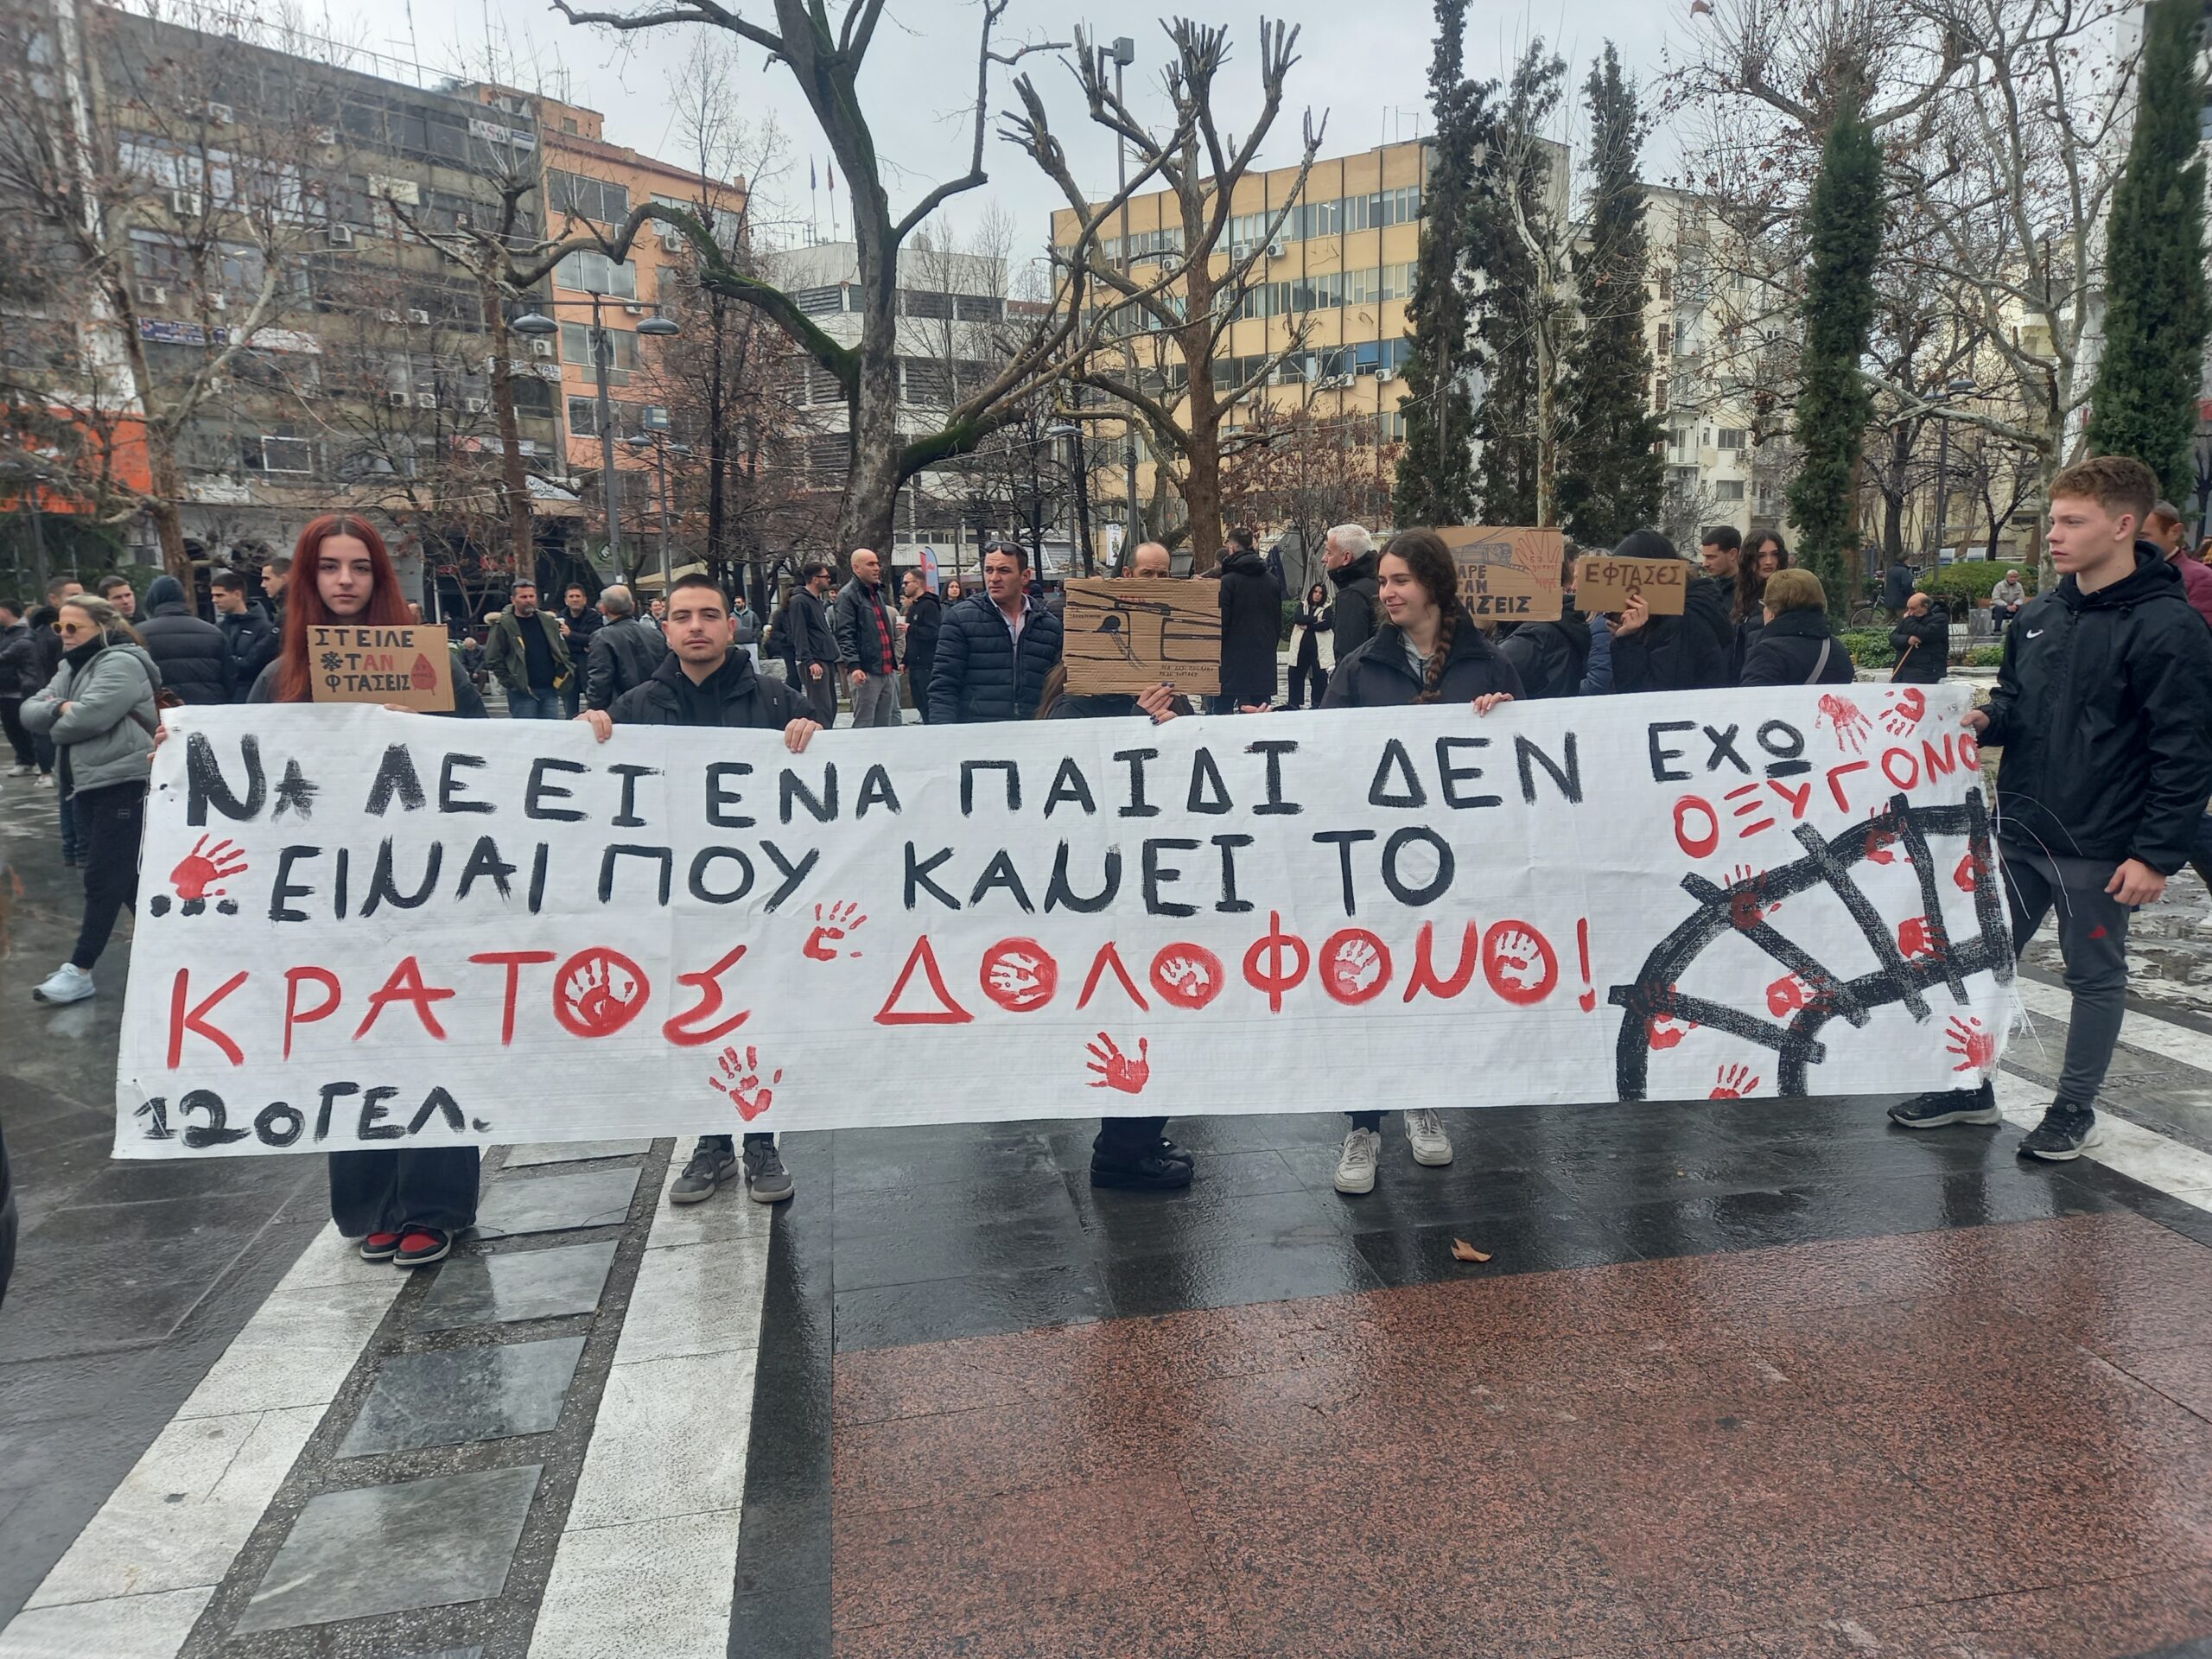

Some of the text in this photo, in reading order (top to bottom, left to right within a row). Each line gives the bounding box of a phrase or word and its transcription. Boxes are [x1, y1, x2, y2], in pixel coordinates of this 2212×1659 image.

[1458, 564, 1487, 579] ΑΡΕ
[1586, 563, 1681, 586] ΕΦΤΑΣΕΣ
[1458, 579, 1488, 594] ΑΝ
[1459, 594, 1532, 614] ΑΣΕΙΣ
[315, 628, 415, 648] ΣΤΕΙΛΕ
[325, 674, 410, 692] ΦΤΑΣΕΙΣ
[365, 742, 664, 828] ΛΕΕΙ
[705, 761, 901, 829] ΕΝΑ
[960, 740, 1302, 820] ΠΑΙΔΙ
[1368, 731, 1583, 810] ΔΕΝ
[1648, 719, 1812, 783] ΕΧΩ
[1673, 732, 1981, 859] ΟΞΥΓΟΝΟ
[597, 840, 820, 913] ΠΟΥ
[903, 834, 1255, 918] ΚΑΝΕΙ
[1312, 825, 1455, 918] ΤΟ
[167, 910, 1596, 1070] ΚΡΑΤΟΣ ΔΟΛΟΦΟΝΟ!
